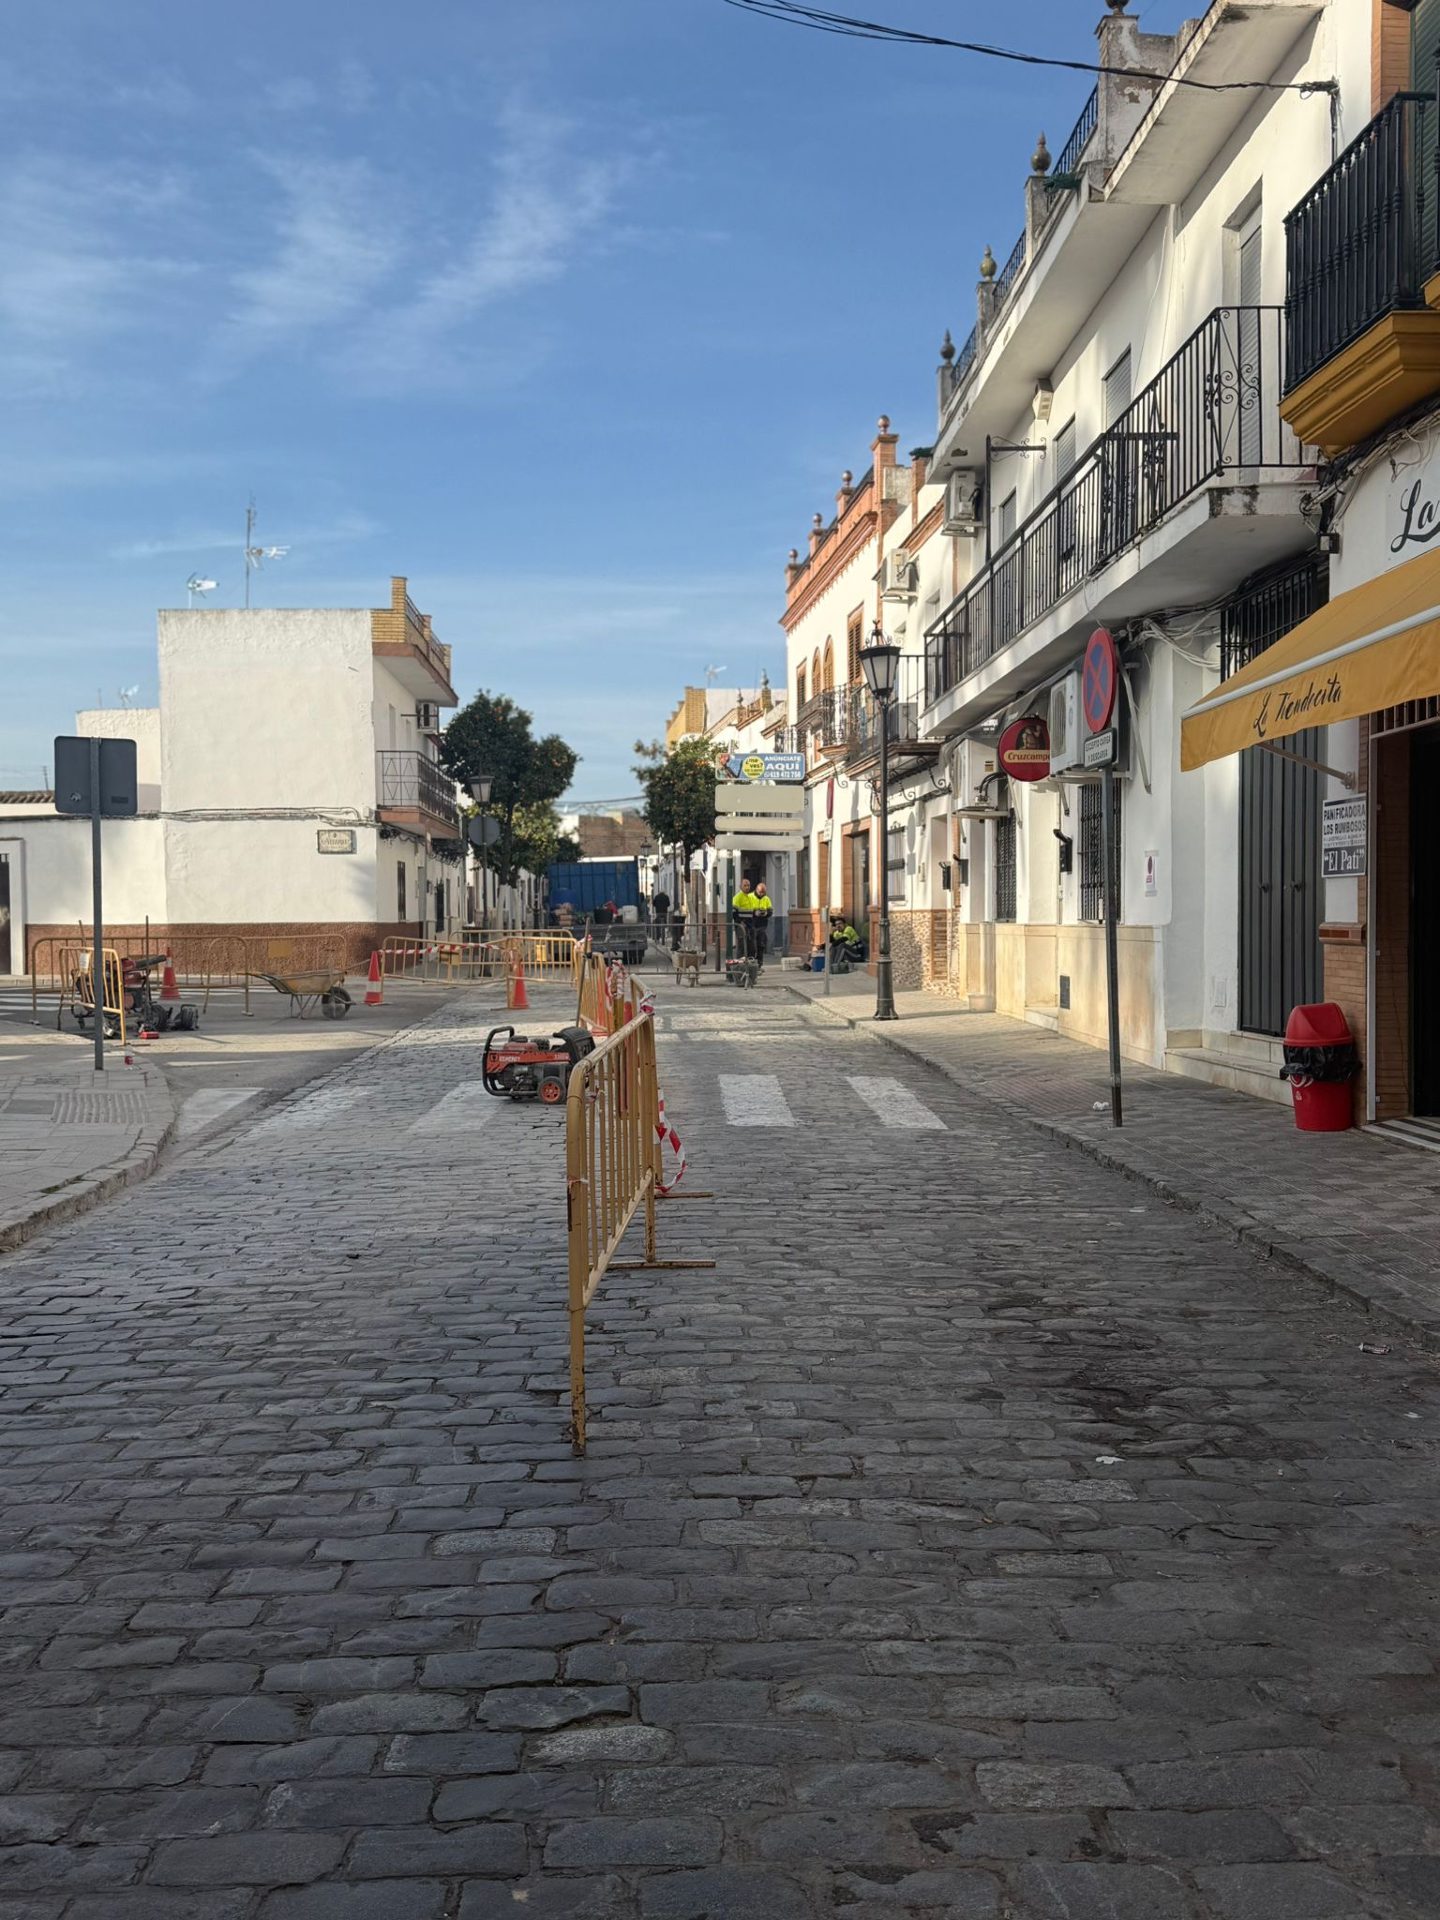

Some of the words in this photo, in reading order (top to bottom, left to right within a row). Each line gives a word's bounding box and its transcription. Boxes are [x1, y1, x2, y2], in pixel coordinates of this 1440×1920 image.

[1391, 479, 1440, 553] La
[1253, 692, 1271, 737] La
[1323, 804, 1366, 821] PANIFICADORA
[1323, 823, 1334, 836] LOS
[1334, 819, 1366, 835] RUMBOSOS
